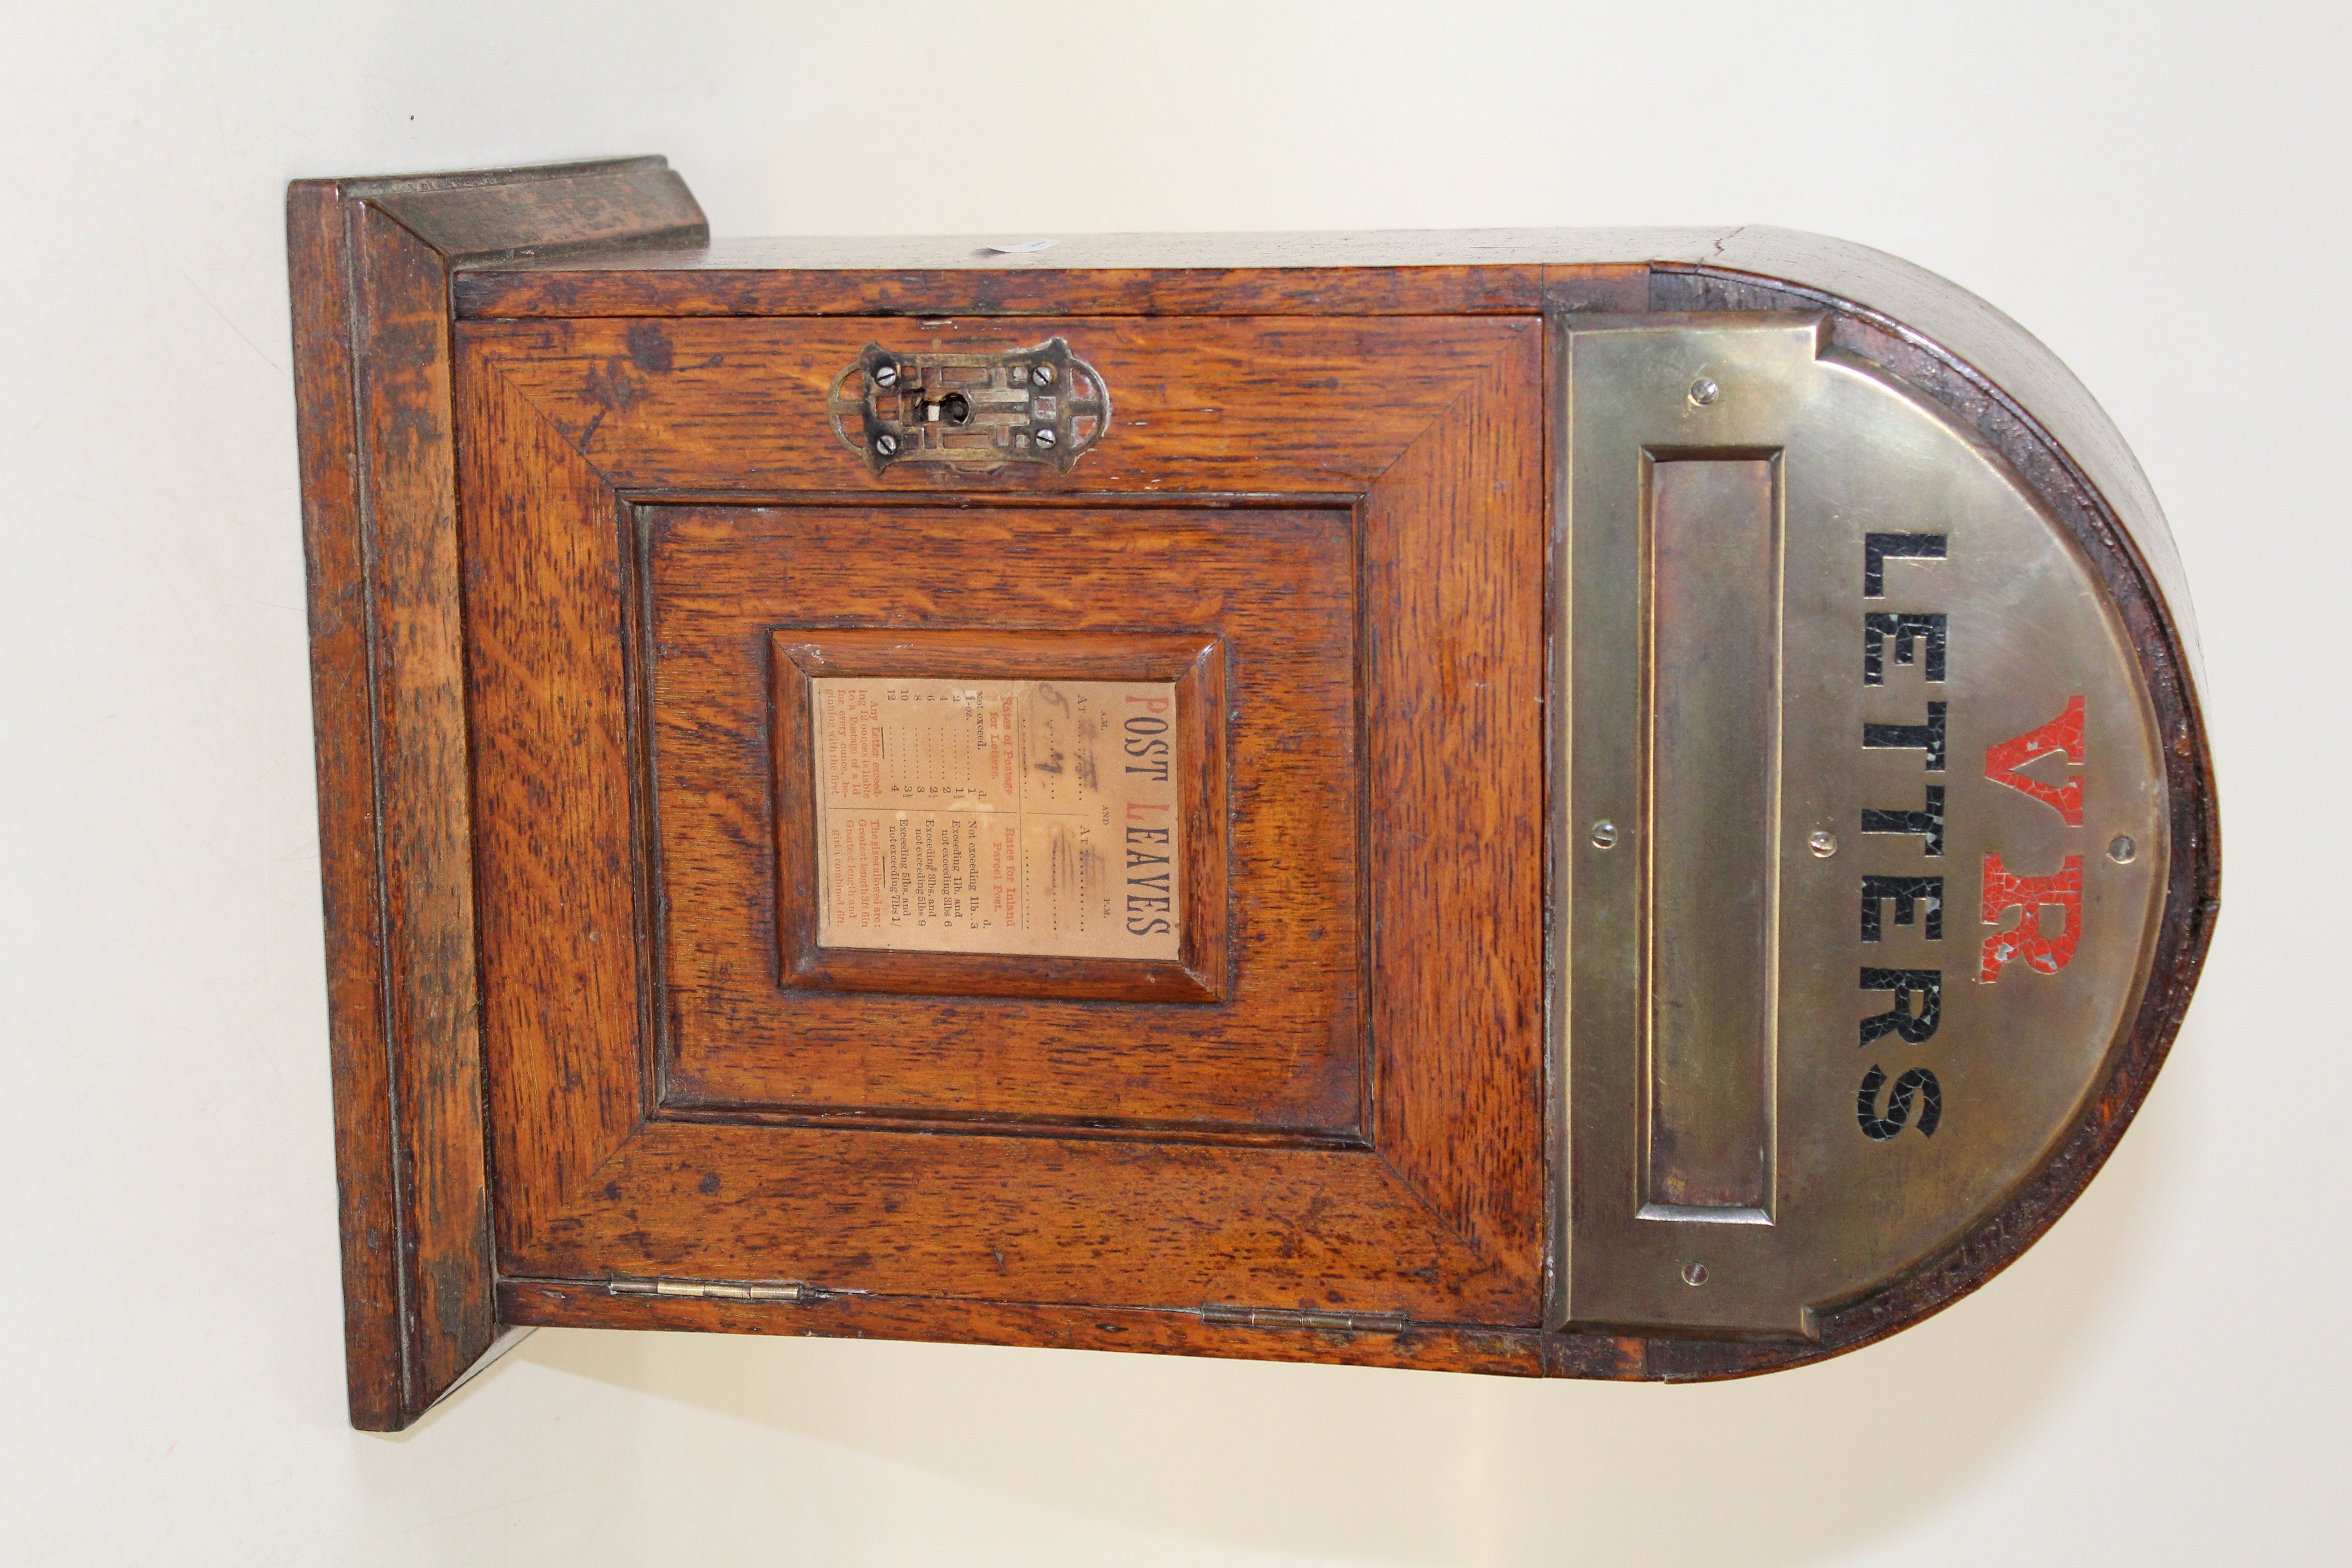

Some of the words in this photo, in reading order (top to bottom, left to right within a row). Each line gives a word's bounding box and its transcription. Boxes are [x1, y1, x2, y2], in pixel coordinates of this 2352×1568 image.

[837, 690, 846, 704] for
[848, 690, 856, 700] to
[857, 690, 868, 706] ing
[887, 689, 896, 701] 12
[900, 690, 909, 701] 10
[825, 689, 836, 728] ginning
[860, 710, 868, 720] 12
[869, 701, 879, 720] Any
[989, 712, 999, 729] for
[1001, 697, 1012, 730] Rates
[836, 711, 847, 736] every
[849, 716, 858, 754] Postage
[977, 714, 986, 750] exceed.
[828, 731, 837, 752] with
[860, 724, 870, 757] ounces
[871, 727, 880, 757] Letter
[1003, 735, 1013, 745] of
[1124, 695, 1169, 781] POST
[830, 755, 838, 770] the
[852, 759, 859, 769] of
[990, 735, 1000, 780] Letters.
[862, 771, 871, 798] liable
[872, 762, 882, 798] exceed-
[1003, 750, 1014, 795] Postage
[830, 775, 839, 795] first
[842, 782, 850, 798] be-
[978, 791, 986, 799] d.
[846, 820, 855, 861] Greatest
[858, 819, 868, 861] Greatest
[870, 820, 880, 839] The
[889, 826, 897, 843] not
[915, 829, 924, 845] not
[941, 829, 950, 846] not
[968, 820, 977, 839] Not
[1855, 533, 1948, 1142] LETTERS
[831, 830, 842, 854] girth
[871, 842, 880, 866] sizes
[898, 818, 909, 869] Exceeding
[925, 819, 935, 871] Exceeding
[951, 820, 961, 872] Exceeding
[1005, 828, 1015, 861] Rates
[889, 844, 899, 892] exceeding
[915, 847, 925, 895] exceeding
[941, 848, 951, 895] exceeding
[969, 843, 979, 891] exceeding
[992, 842, 1002, 880] Parcel
[1125, 802, 1171, 936] LEAVES
[834, 859, 844, 905] combined
[845, 865, 856, 896] length
[857, 864, 869, 895] length
[872, 868, 882, 904] allowed
[1006, 866, 1015, 882] for
[848, 900, 857, 918] and
[861, 896, 869, 910] 3ft
[902, 898, 911, 916] and
[928, 899, 936, 917] and
[954, 899, 962, 918] and
[993, 885, 1003, 912] Post.
[1006, 888, 1015, 927] Inland
[836, 911, 844, 927] 6ft.
[861, 912, 869, 927] 6in
[982, 920, 991, 929] d.
